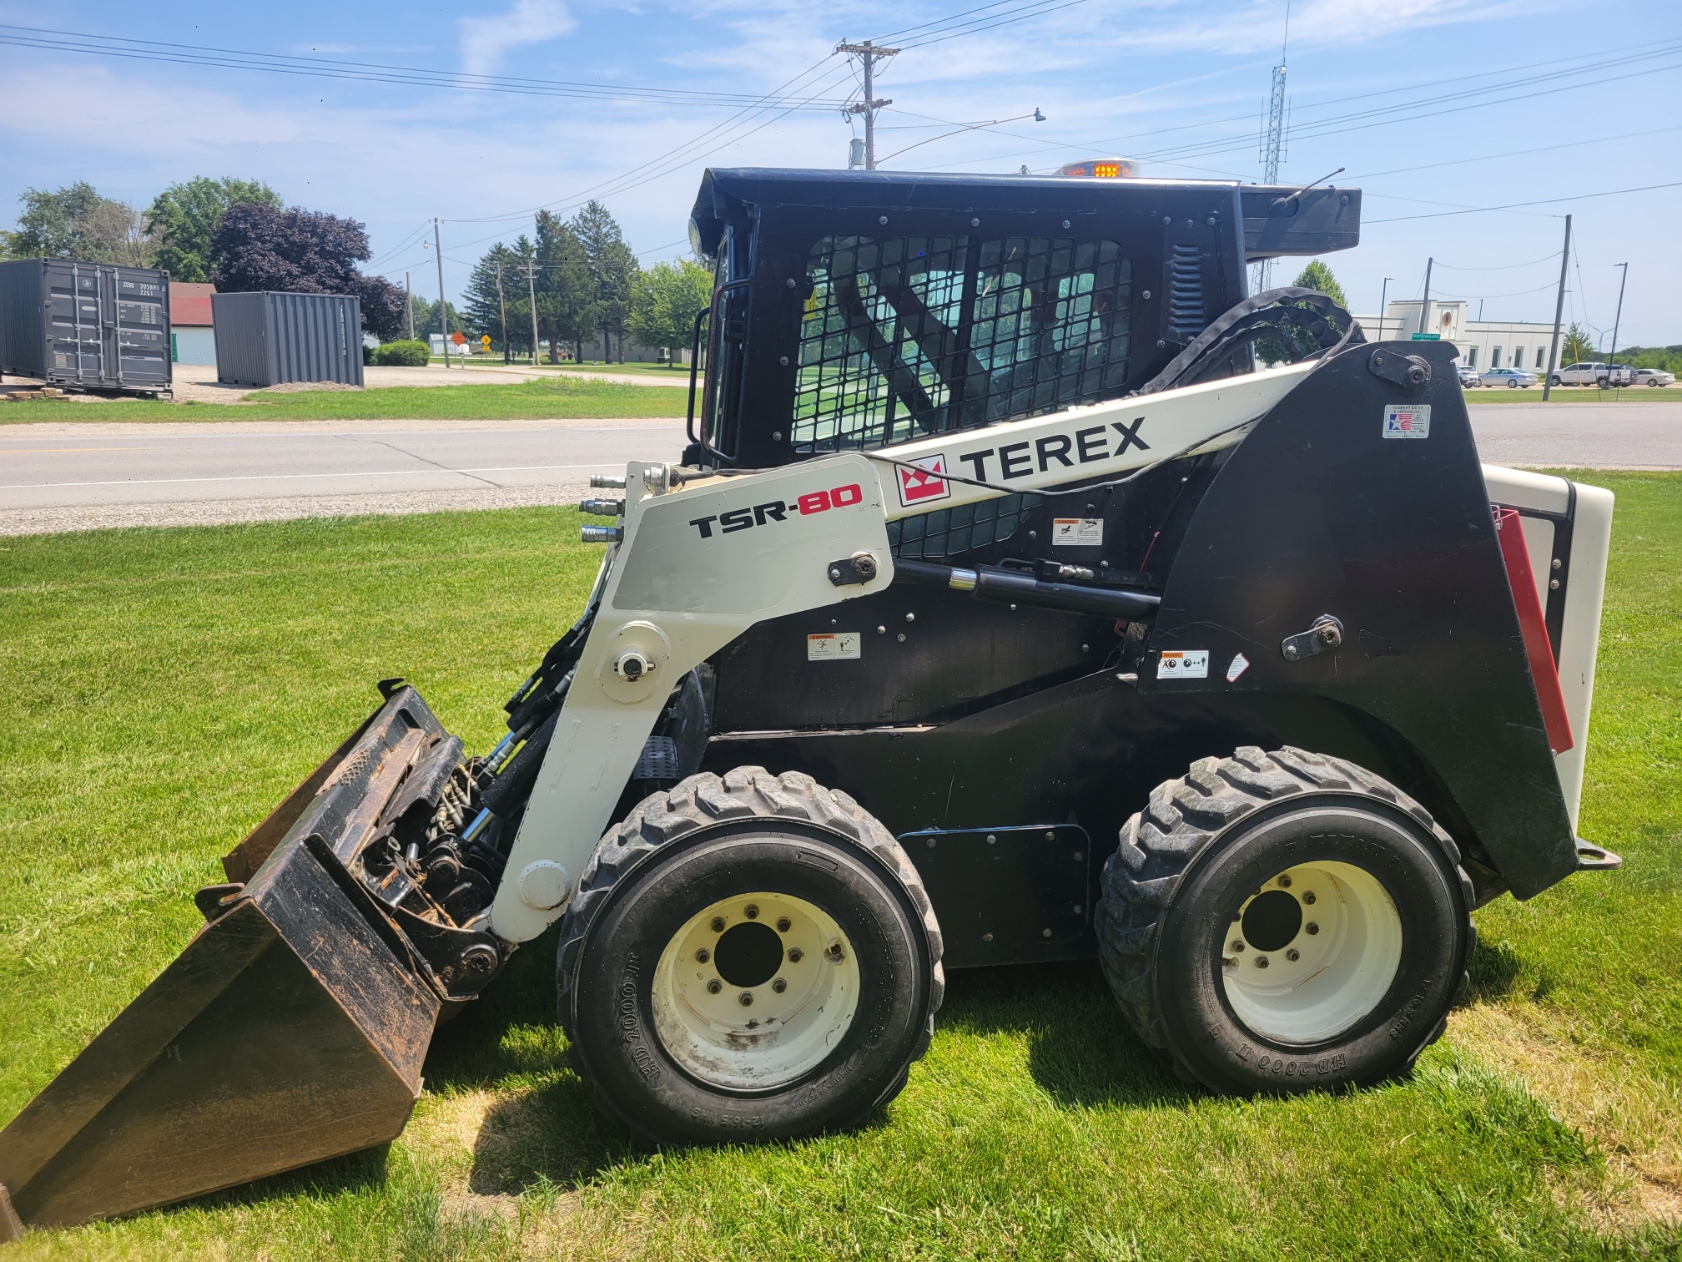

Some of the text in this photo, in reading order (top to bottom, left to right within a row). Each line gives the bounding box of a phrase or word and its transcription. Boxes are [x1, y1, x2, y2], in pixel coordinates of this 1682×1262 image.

[959, 416, 1151, 482] TEREX
[689, 483, 863, 539] TSR-80
[1258, 1054, 1310, 1076] 2000
[1315, 1051, 1348, 1075] HD
